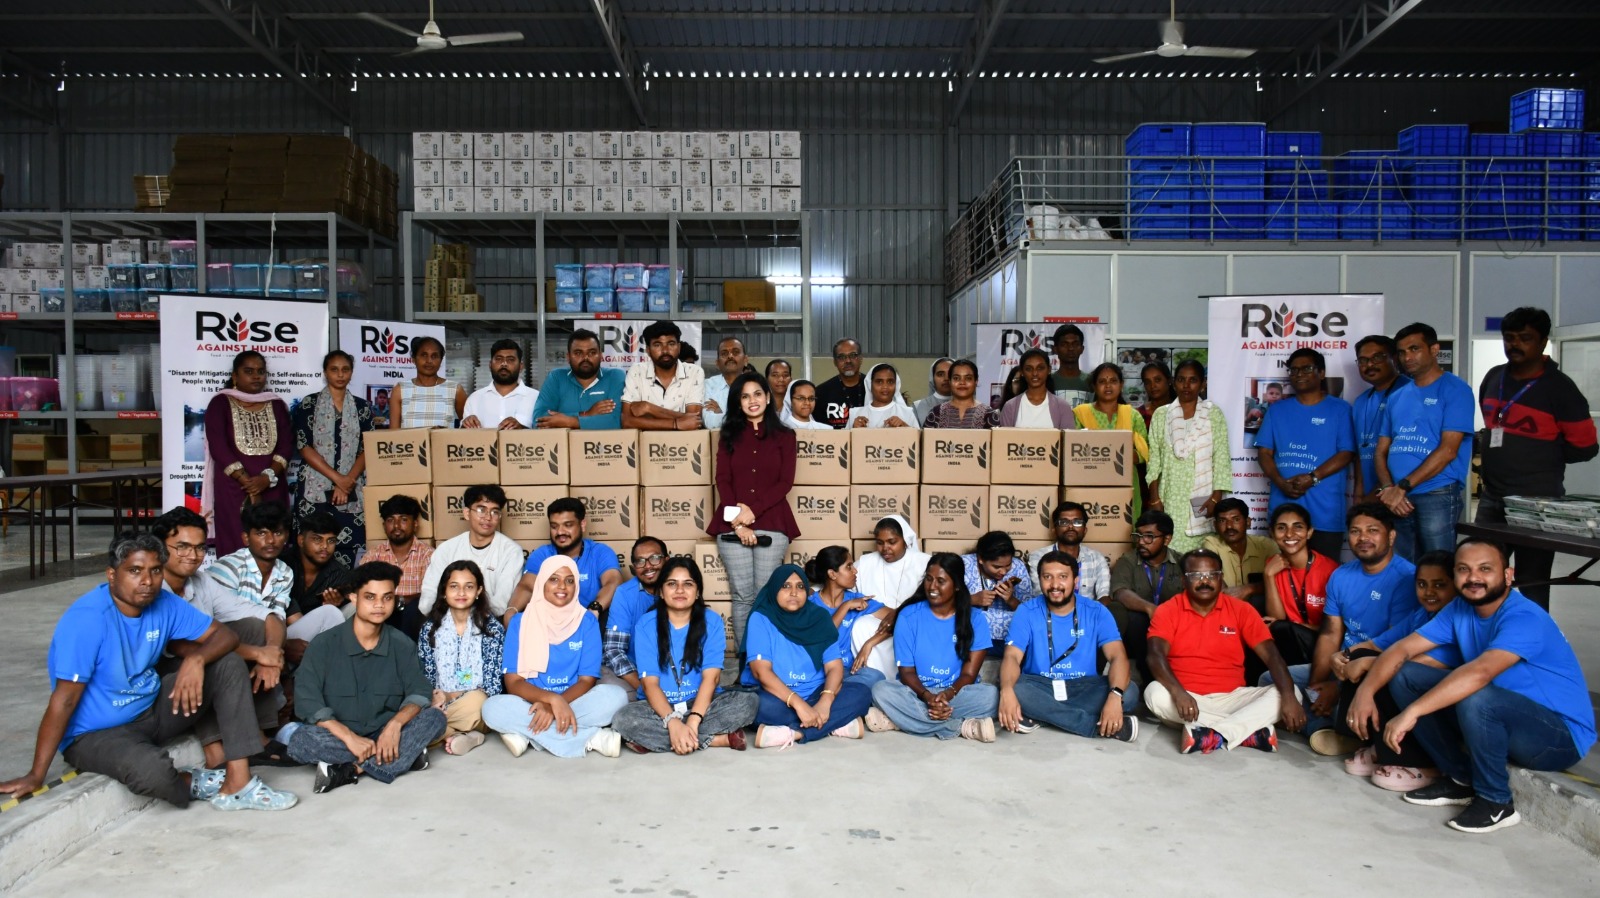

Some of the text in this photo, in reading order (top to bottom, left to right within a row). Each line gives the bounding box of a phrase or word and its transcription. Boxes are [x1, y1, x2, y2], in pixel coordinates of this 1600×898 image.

[195, 311, 299, 343] Rise
[1241, 302, 1349, 338] Rise
[361, 325, 410, 354] Ris
[1241, 340, 1348, 350] AGAINST HUNGER
[197, 344, 299, 354] AGAINST HUNGER
[199, 370, 233, 378] Mitigation
[377, 441, 414, 455] Rise
[447, 444, 485, 458] Rise
[506, 443, 545, 457] Rise
[584, 441, 623, 455] Rise
[649, 443, 688, 458] Rise
[797, 441, 835, 455] Rise
[865, 445, 903, 459] Rise
[935, 440, 974, 454] Rise
[1007, 443, 1046, 457] Rise
[1071, 443, 1111, 457] Rise
[1289, 442, 1307, 450] food
[1279, 452, 1318, 462] community
[506, 498, 545, 512] Rise
[652, 498, 691, 513] Rise
[797, 496, 835, 509] Rise
[858, 494, 897, 509] Rise
[928, 495, 967, 510] Rise
[998, 495, 1037, 510] Rise
[1307, 594, 1325, 602] Rise
[789, 671, 806, 680] food
[930, 665, 950, 675] food
[547, 675, 569, 684] food
